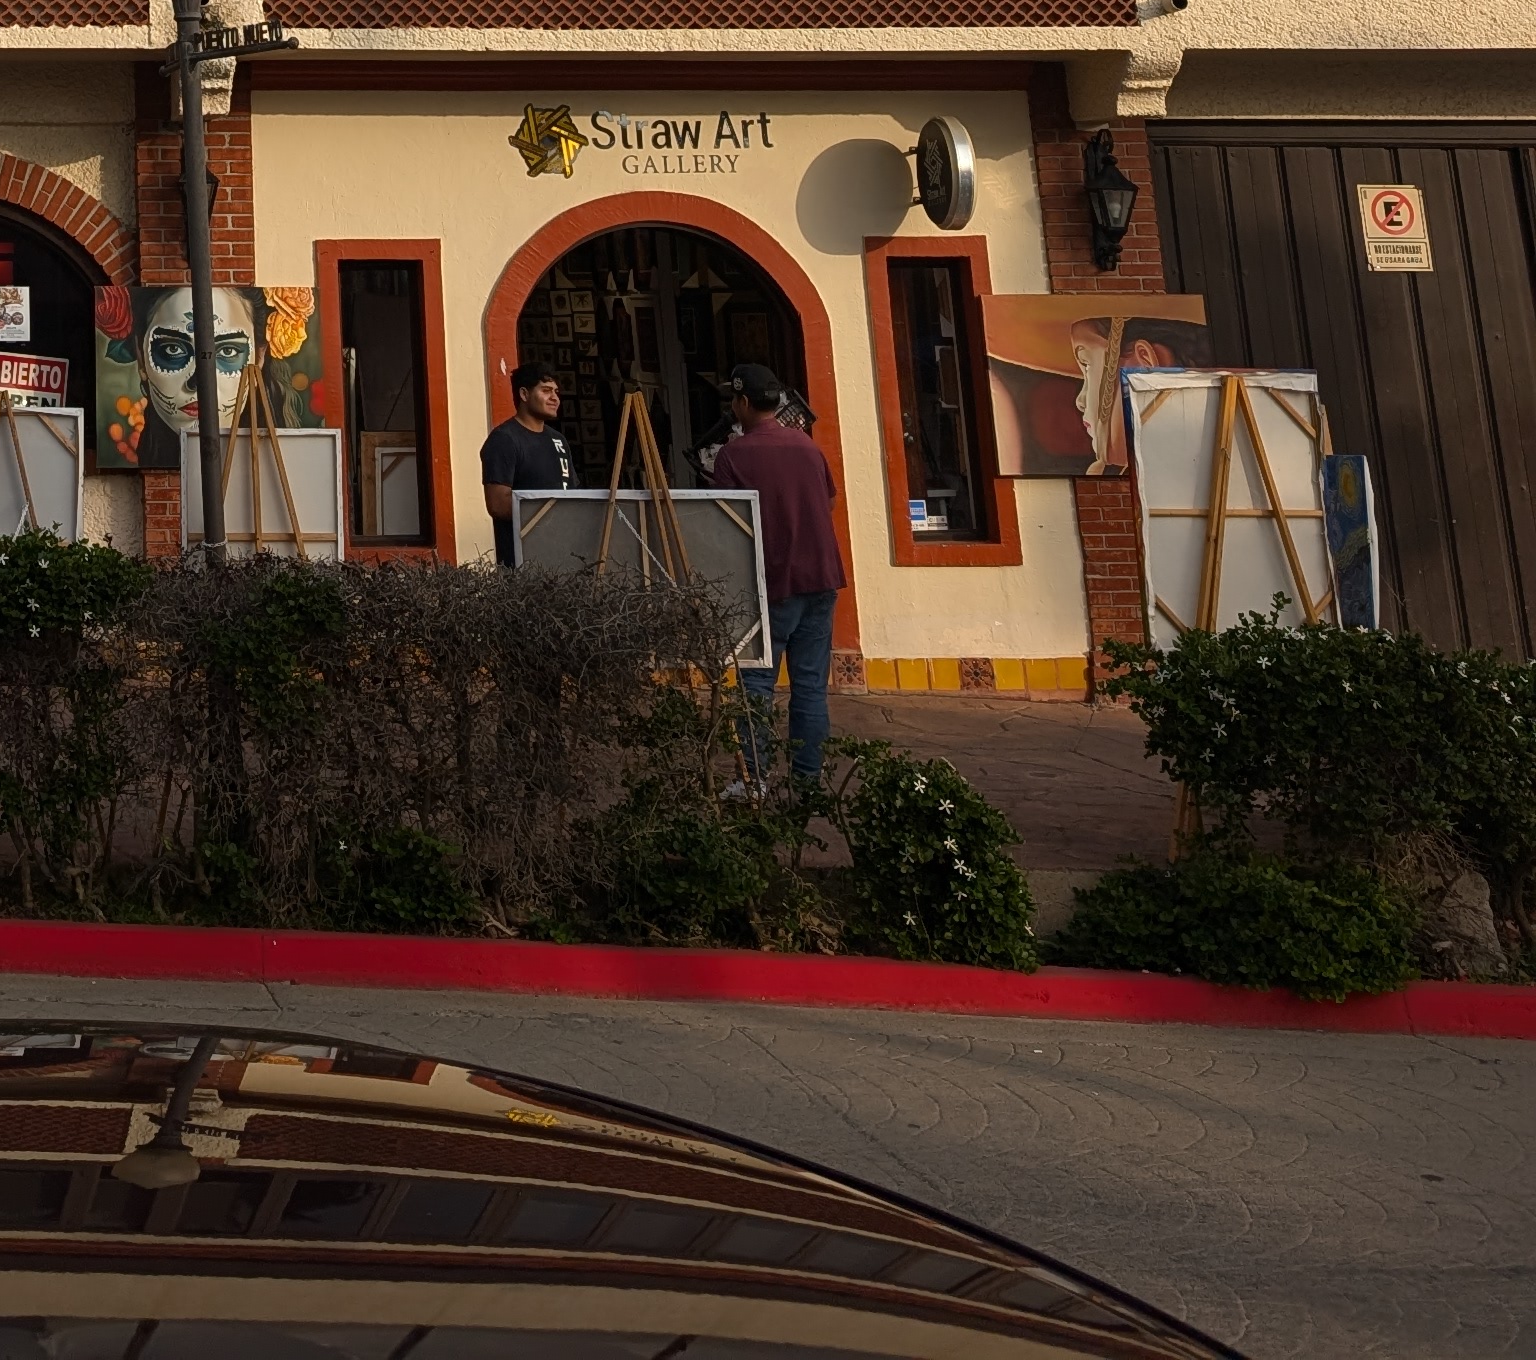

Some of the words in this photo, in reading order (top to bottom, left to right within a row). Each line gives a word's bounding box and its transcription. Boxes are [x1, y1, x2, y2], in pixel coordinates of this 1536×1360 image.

[590, 110, 703, 150] Straw
[712, 111, 774, 149] Art
[621, 153, 740, 175] GALLERY
[1374, 244, 1382, 254] NO
[1382, 244, 1422, 254] ESTACIONARSE
[1384, 256, 1406, 264] USARA
[1406, 256, 1424, 264] GRUA
[200, 351, 213, 360] 27
